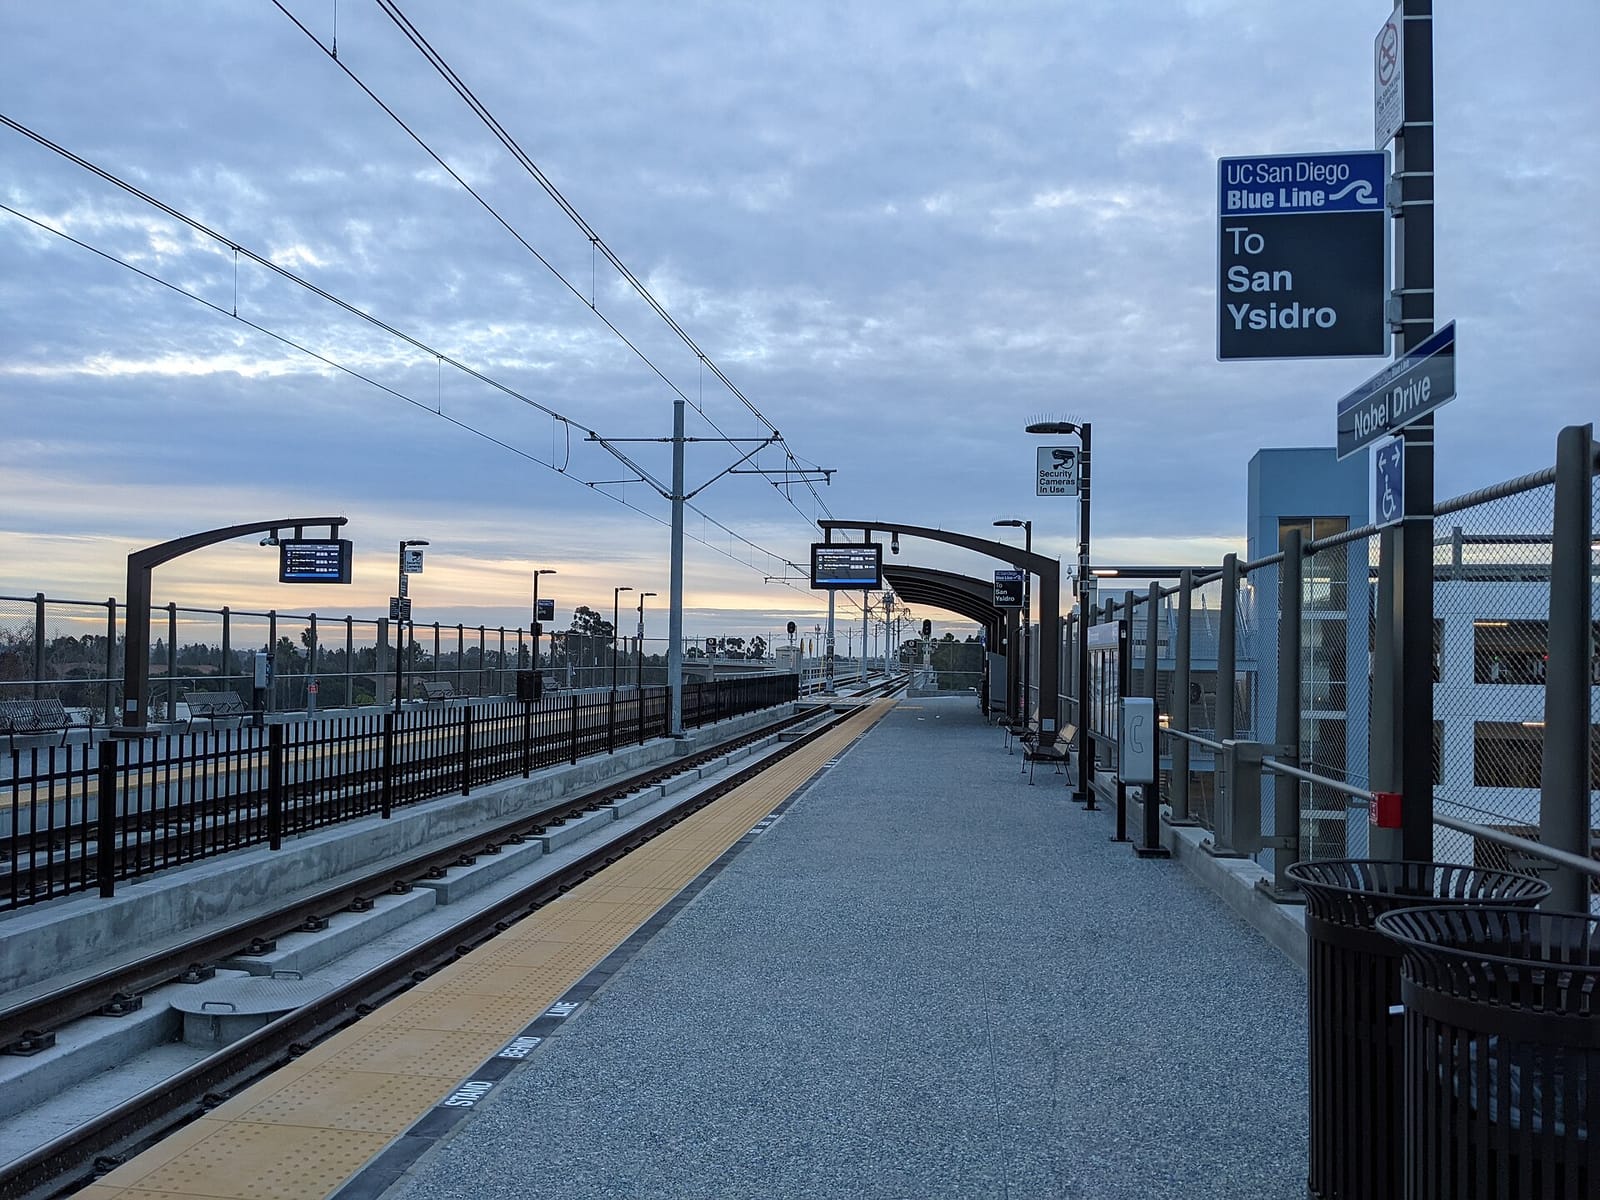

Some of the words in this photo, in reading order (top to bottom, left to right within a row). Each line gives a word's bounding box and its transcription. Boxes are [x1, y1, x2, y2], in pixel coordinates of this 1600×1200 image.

[1227, 164, 1253, 185] UC
[1256, 163, 1292, 184] San
[1296, 161, 1350, 185] Diego
[1227, 189, 1274, 210] Blue
[1279, 187, 1325, 208] Line
[1225, 227, 1265, 255] To
[1227, 265, 1292, 293] San
[1226, 302, 1337, 330] Ysidro
[1354, 393, 1389, 441] Nobel
[1393, 375, 1431, 418] Drive
[1040, 470, 1072, 478] Security
[444, 1081, 493, 1107] STAND
